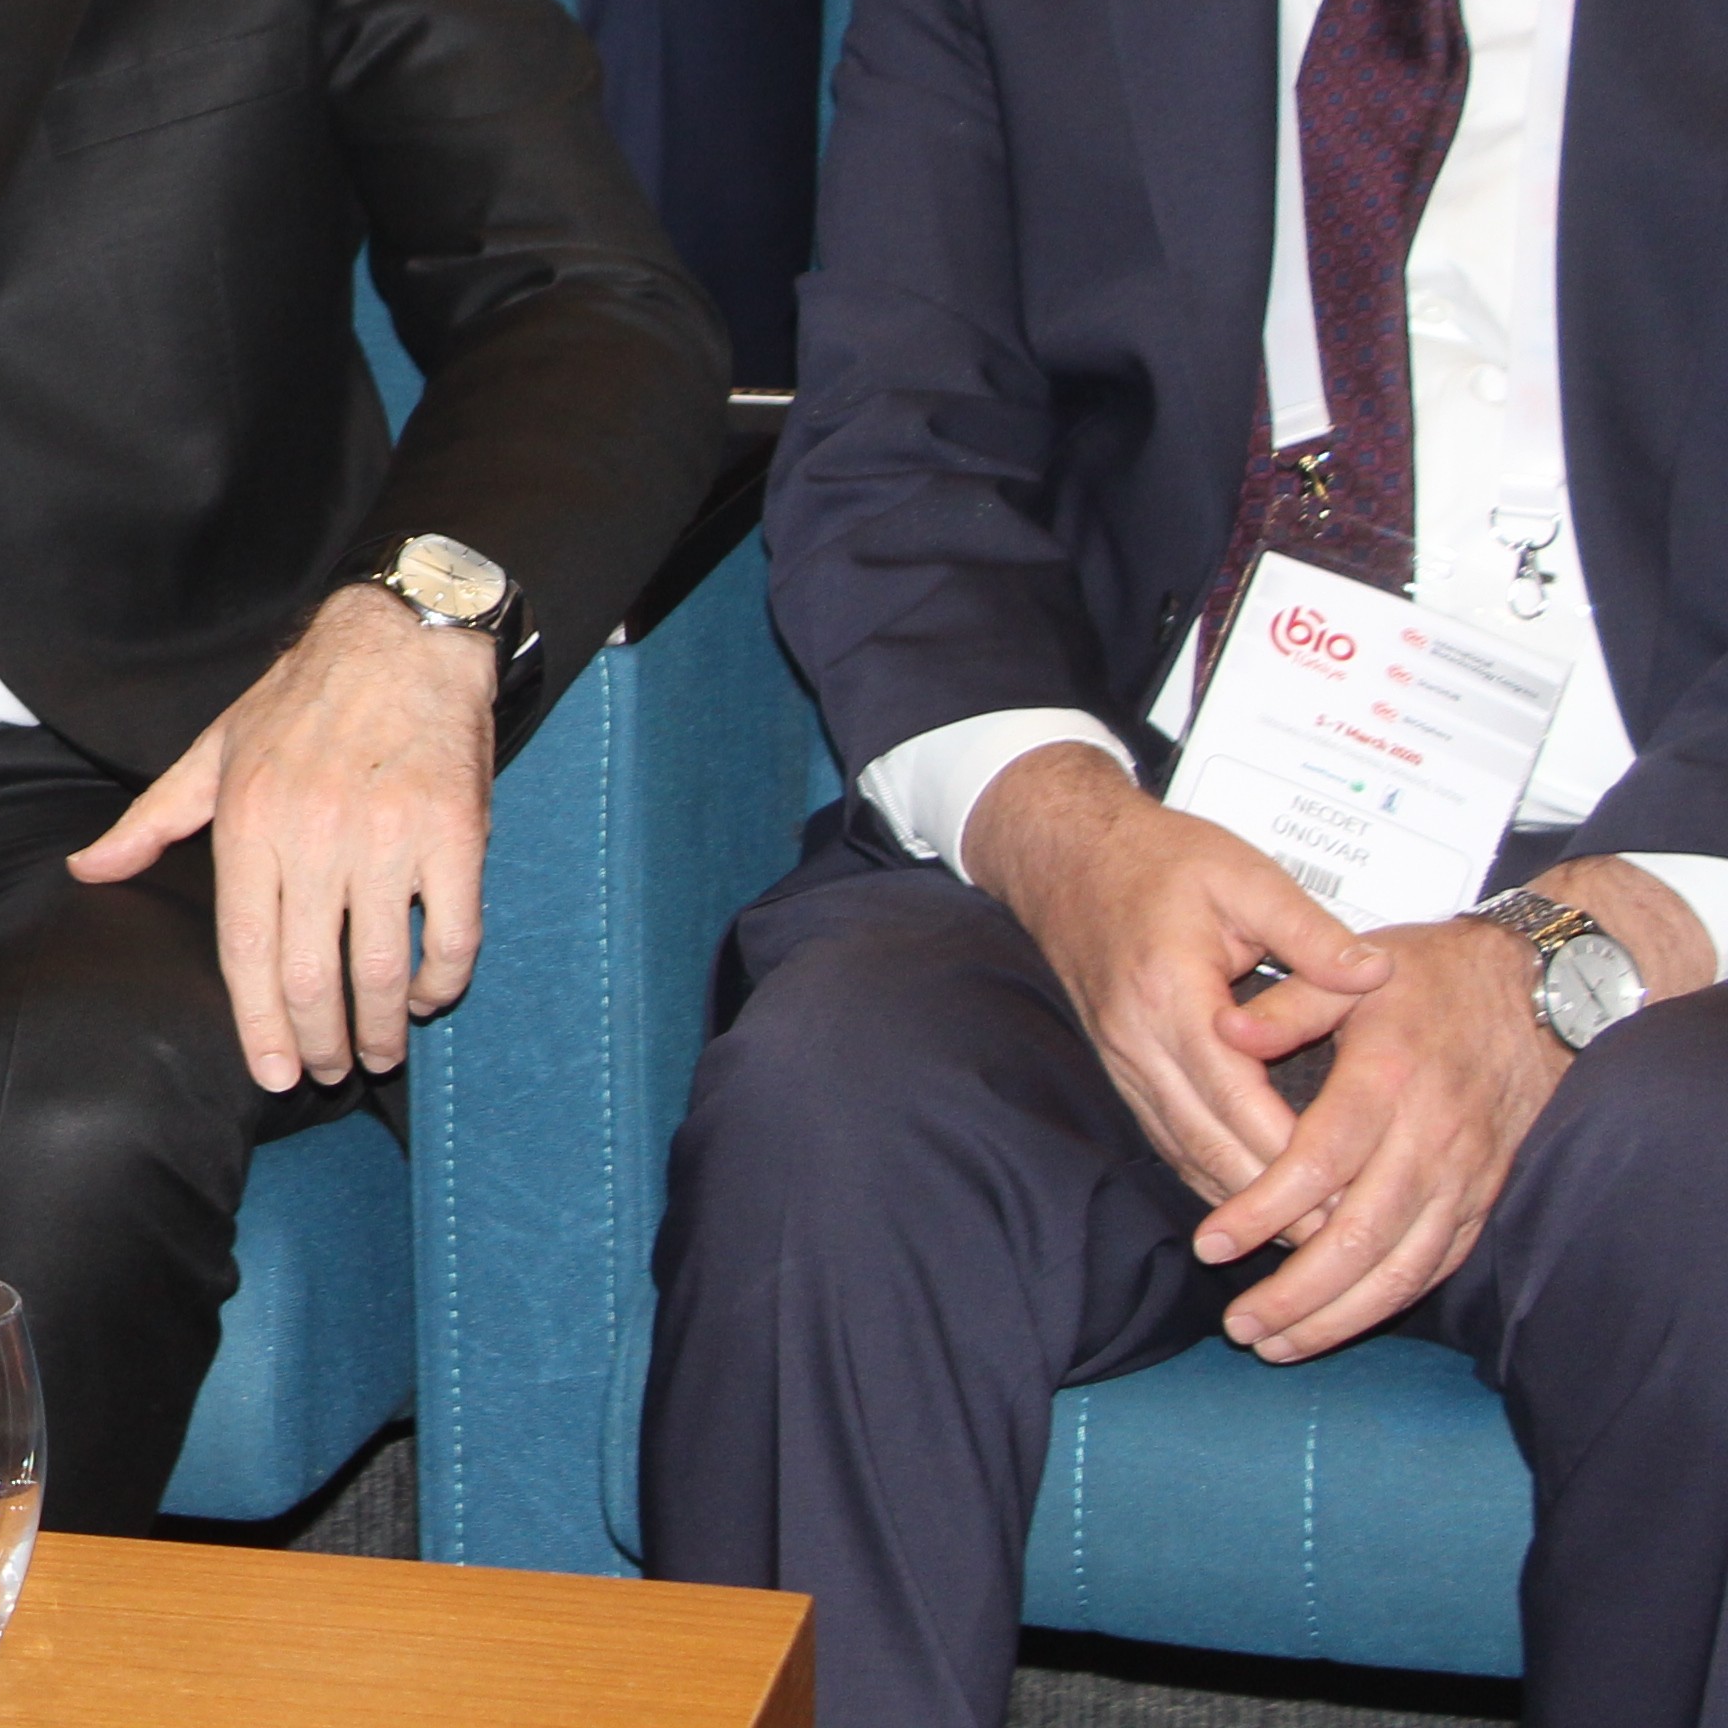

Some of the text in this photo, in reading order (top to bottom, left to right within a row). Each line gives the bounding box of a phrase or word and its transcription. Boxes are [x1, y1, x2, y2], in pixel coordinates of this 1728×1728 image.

[1270, 605, 1357, 662] bio
[1271, 812, 1371, 867] ÜNÜVAR
[1292, 794, 1373, 837] NECDET
